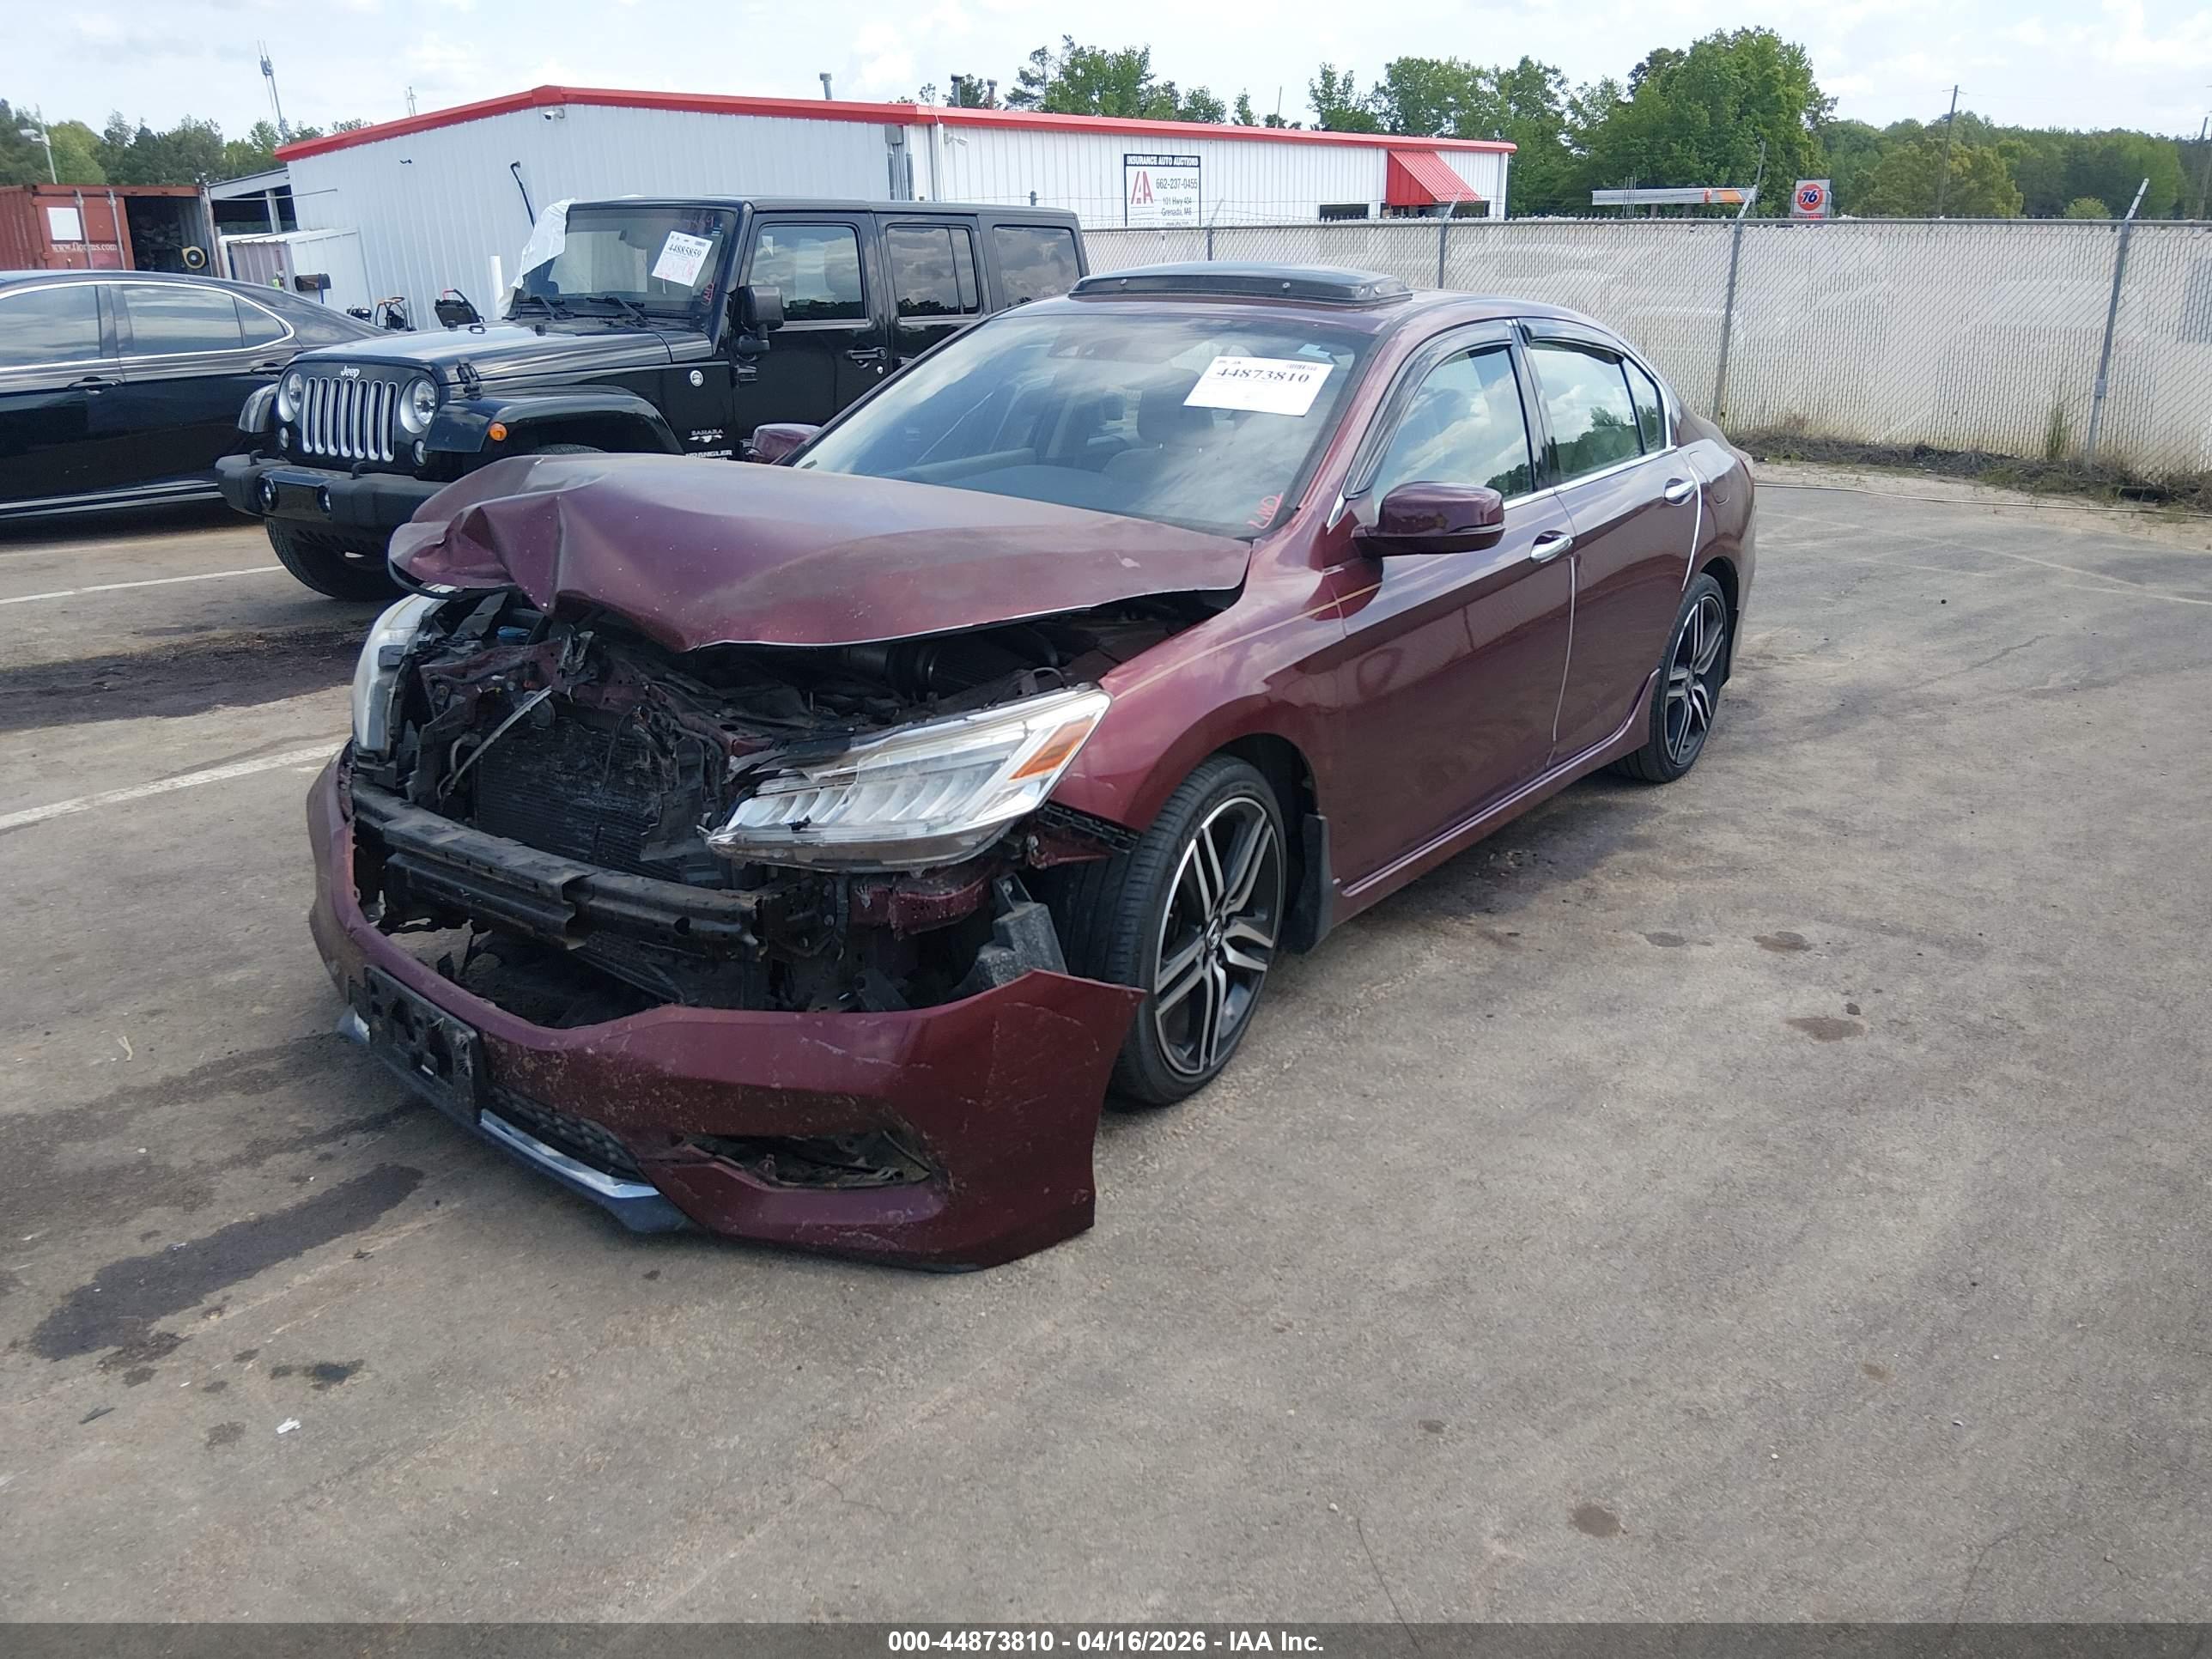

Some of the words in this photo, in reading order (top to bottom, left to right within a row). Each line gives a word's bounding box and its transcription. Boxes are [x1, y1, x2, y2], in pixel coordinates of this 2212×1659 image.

[1127, 155, 1158, 165] INSURANCE
[1158, 156, 1173, 166] AUTO
[1174, 157, 1199, 167] AUCTIONS
[1156, 178, 1198, 189] 662-237-0455
[1801, 189, 1818, 204] 76
[340, 365, 360, 379] Jeep
[1217, 368, 1310, 383] 44873810
